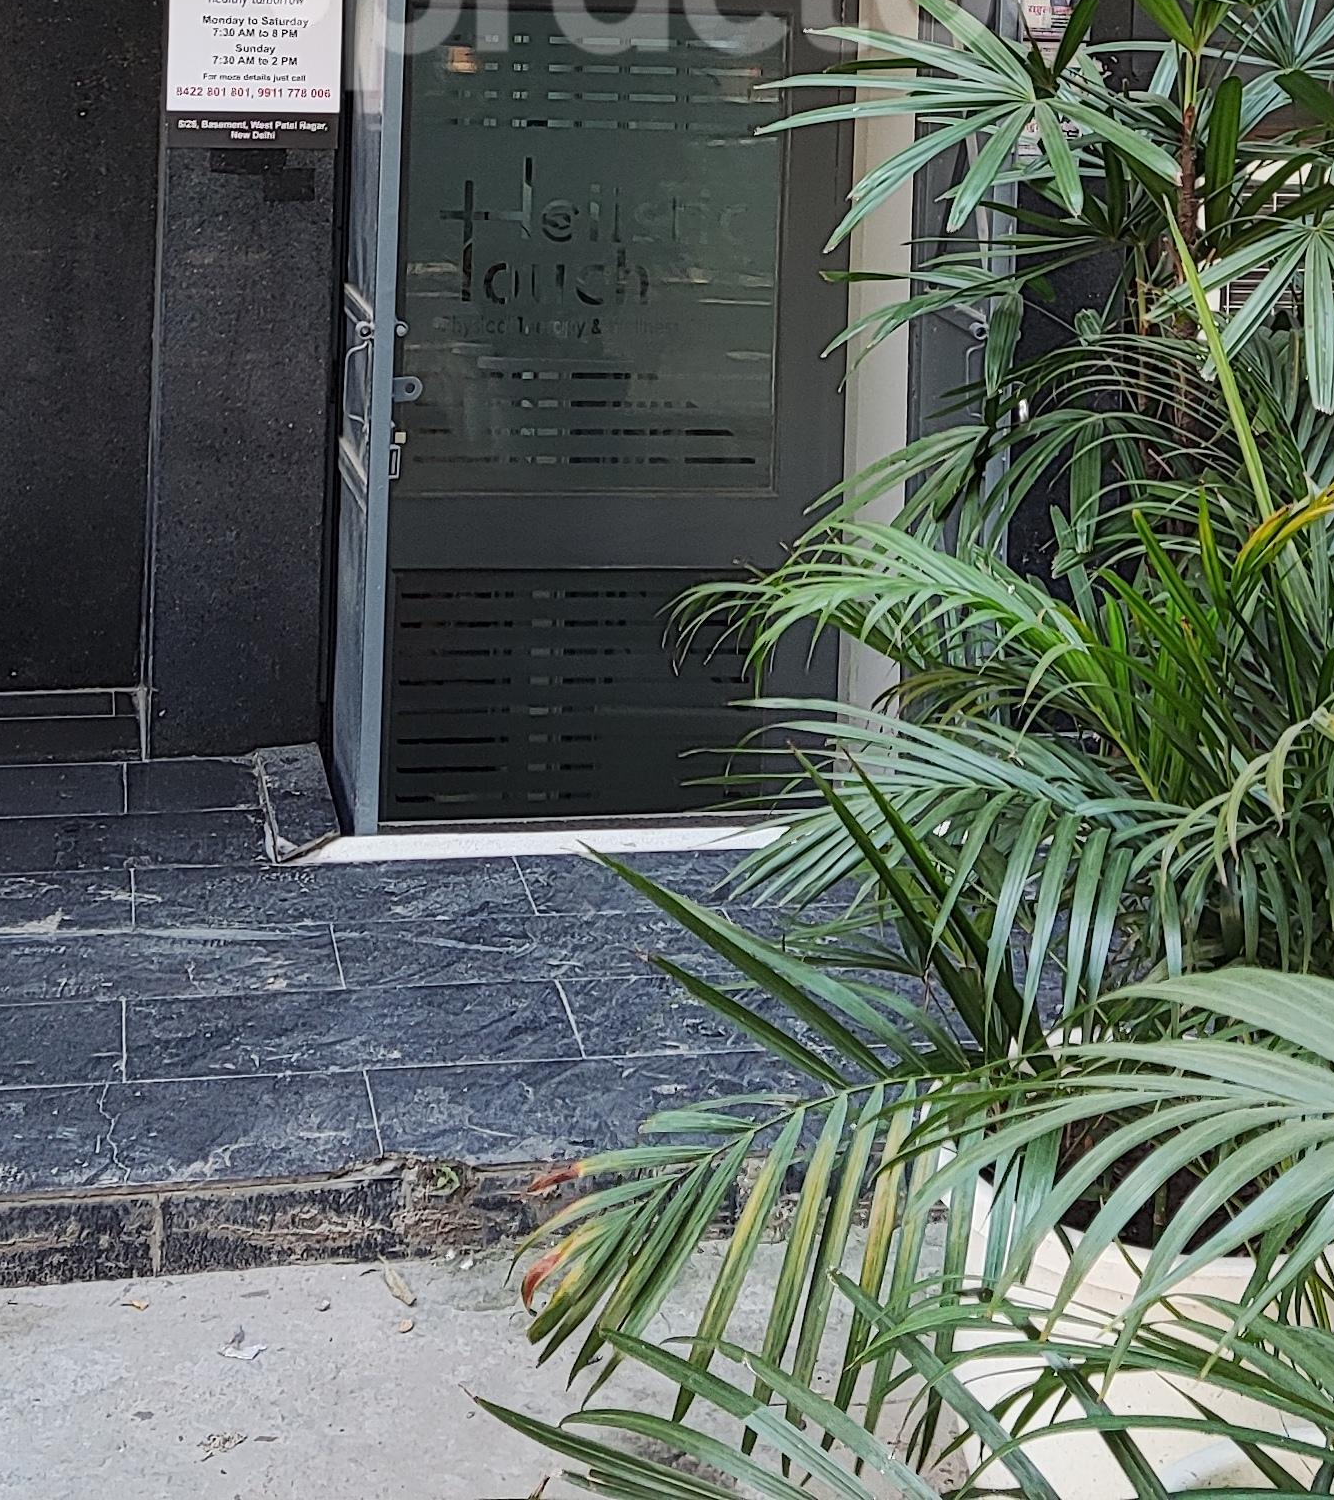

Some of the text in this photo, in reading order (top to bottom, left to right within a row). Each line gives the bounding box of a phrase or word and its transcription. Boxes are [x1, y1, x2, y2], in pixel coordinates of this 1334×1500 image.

[202, 15, 245, 29] Monday
[238, 27, 256, 38] AM
[281, 29, 298, 38] PM
[235, 43, 276, 56] Sunday
